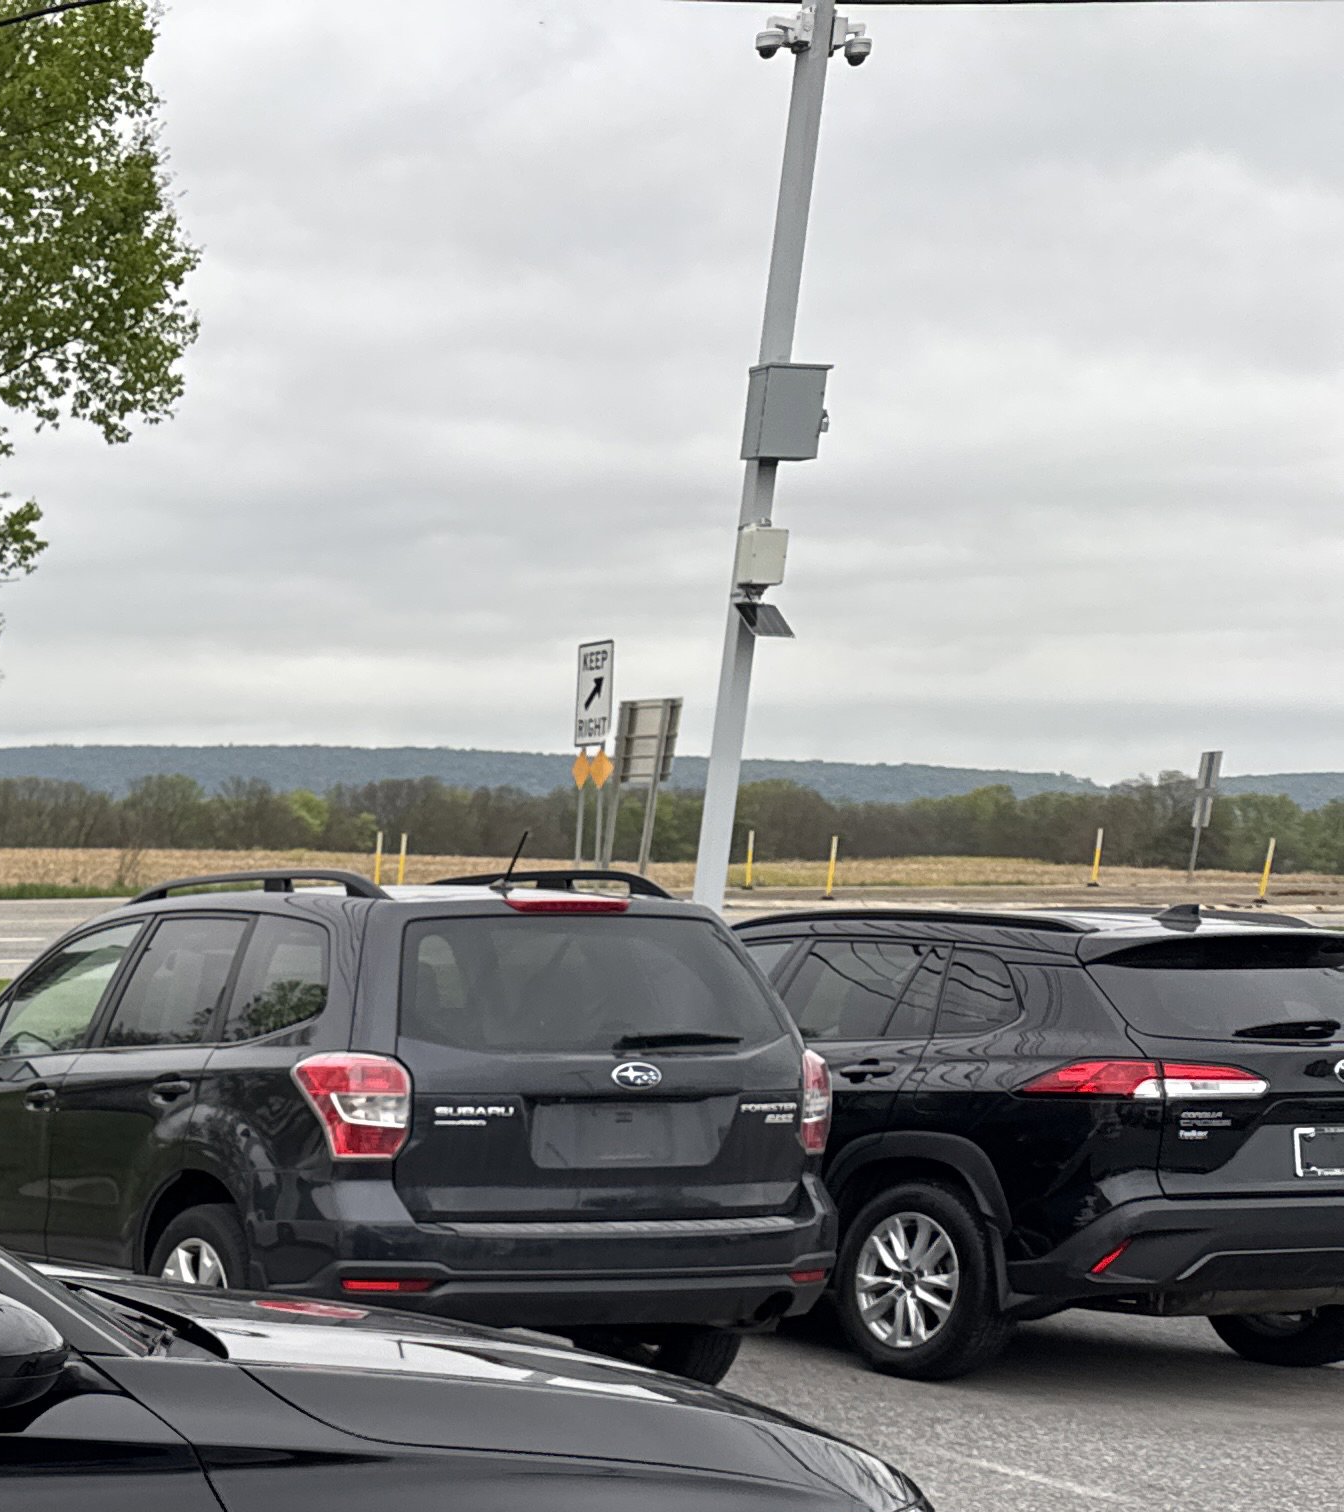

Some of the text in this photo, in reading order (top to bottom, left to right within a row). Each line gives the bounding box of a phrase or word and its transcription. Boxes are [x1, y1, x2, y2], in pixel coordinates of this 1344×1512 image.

[582, 650, 608, 671] KEEP
[578, 717, 607, 738] RIGHT
[434, 1106, 514, 1117] SUBARU
